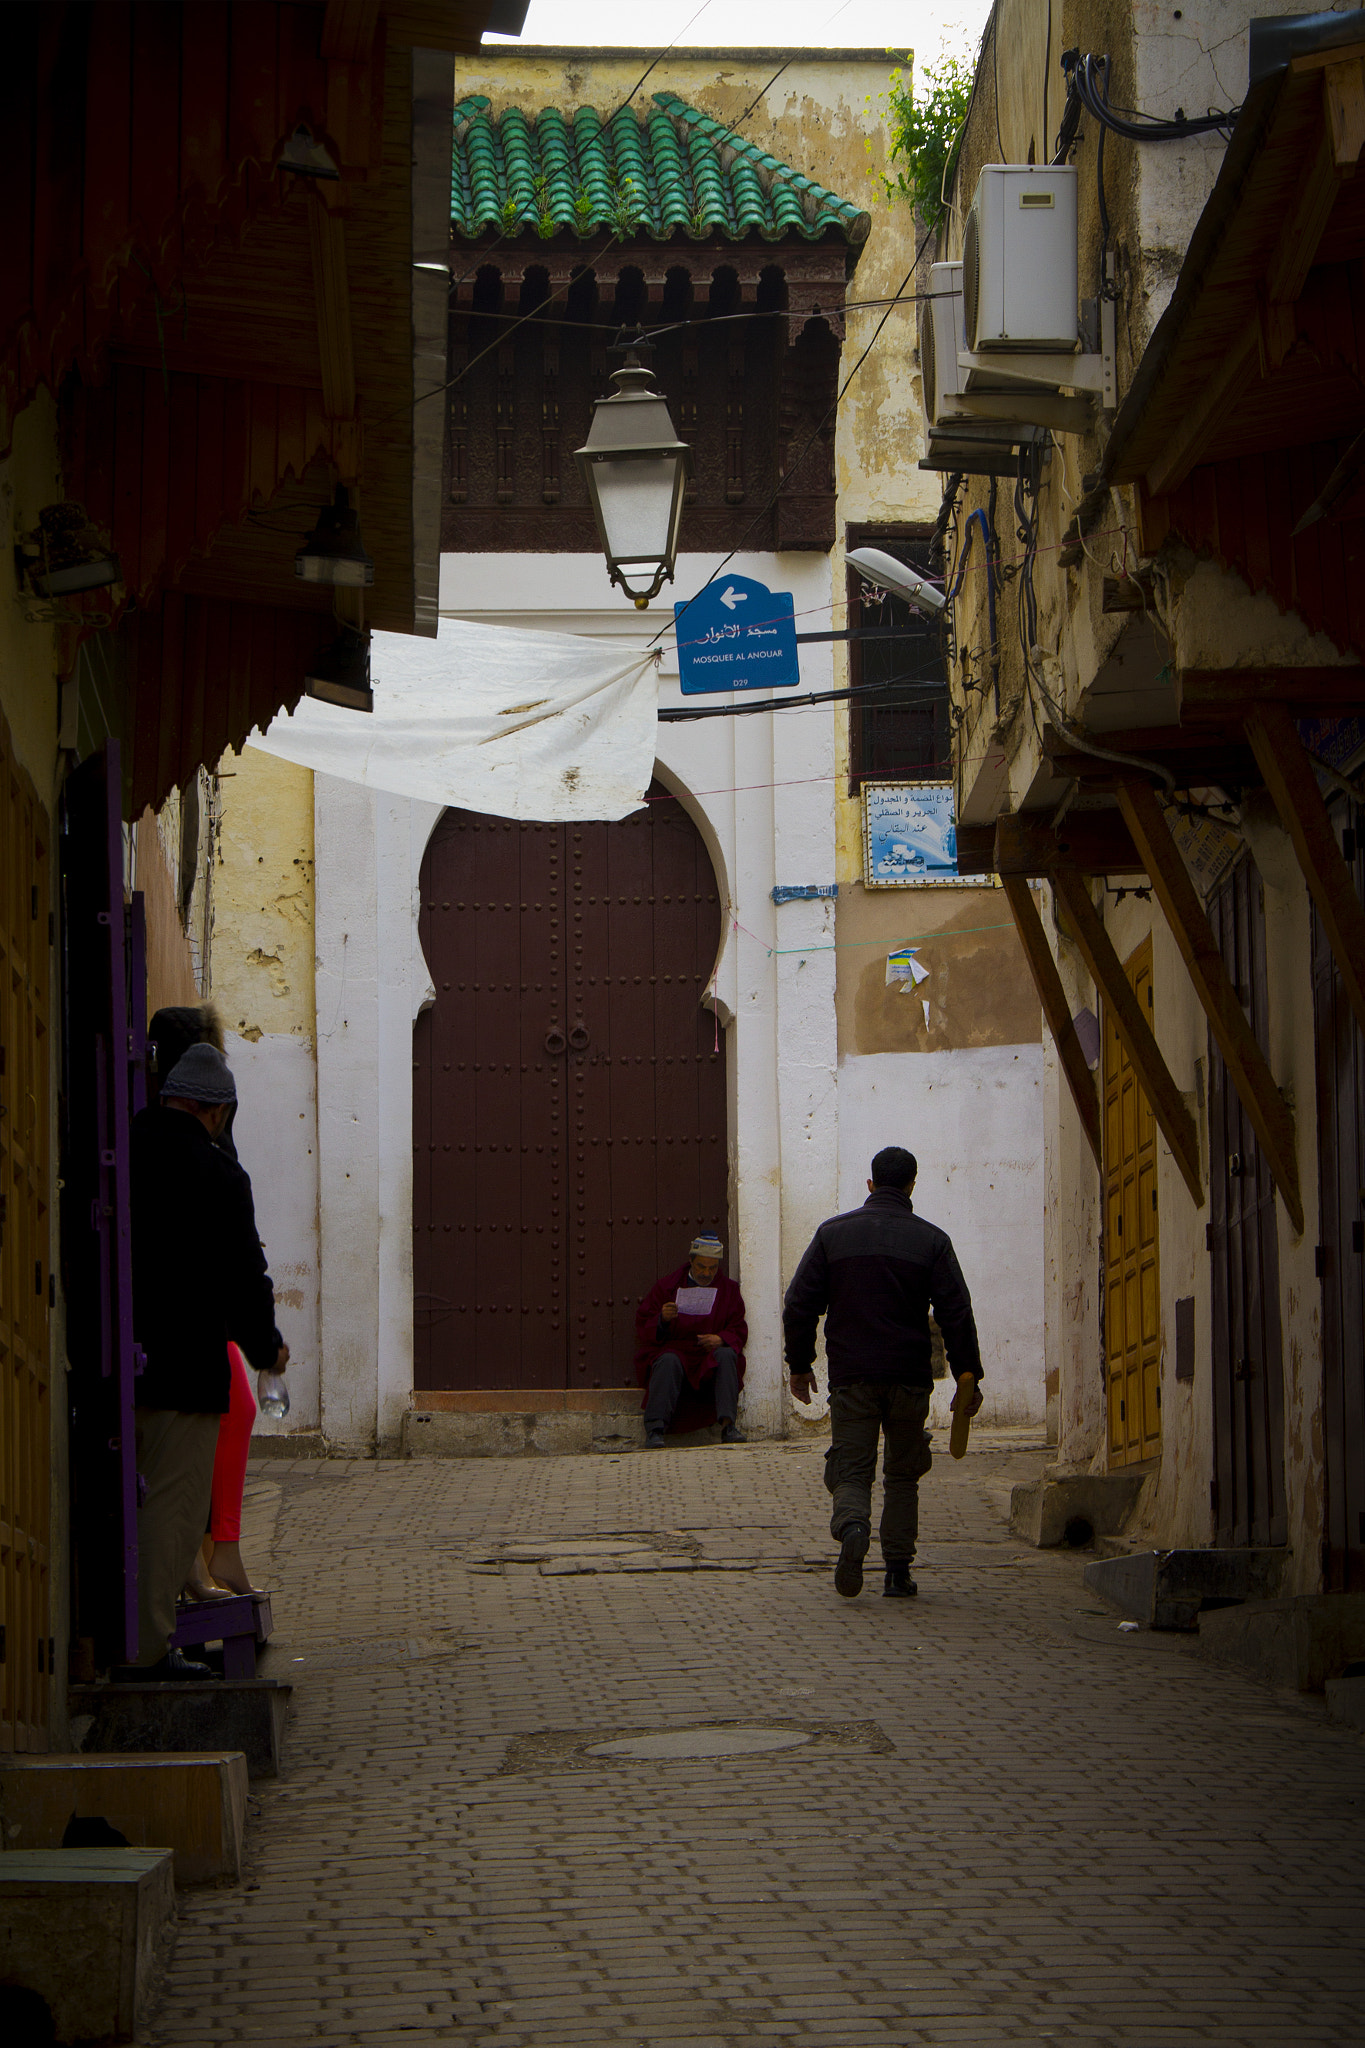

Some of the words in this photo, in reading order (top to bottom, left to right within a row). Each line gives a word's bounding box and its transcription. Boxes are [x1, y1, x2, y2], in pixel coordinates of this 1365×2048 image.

[746, 627, 777, 638] مسجد
[693, 654, 734, 664] MOSQUEE
[747, 650, 782, 659] ANOUAR
[905, 810, 910, 818] و
